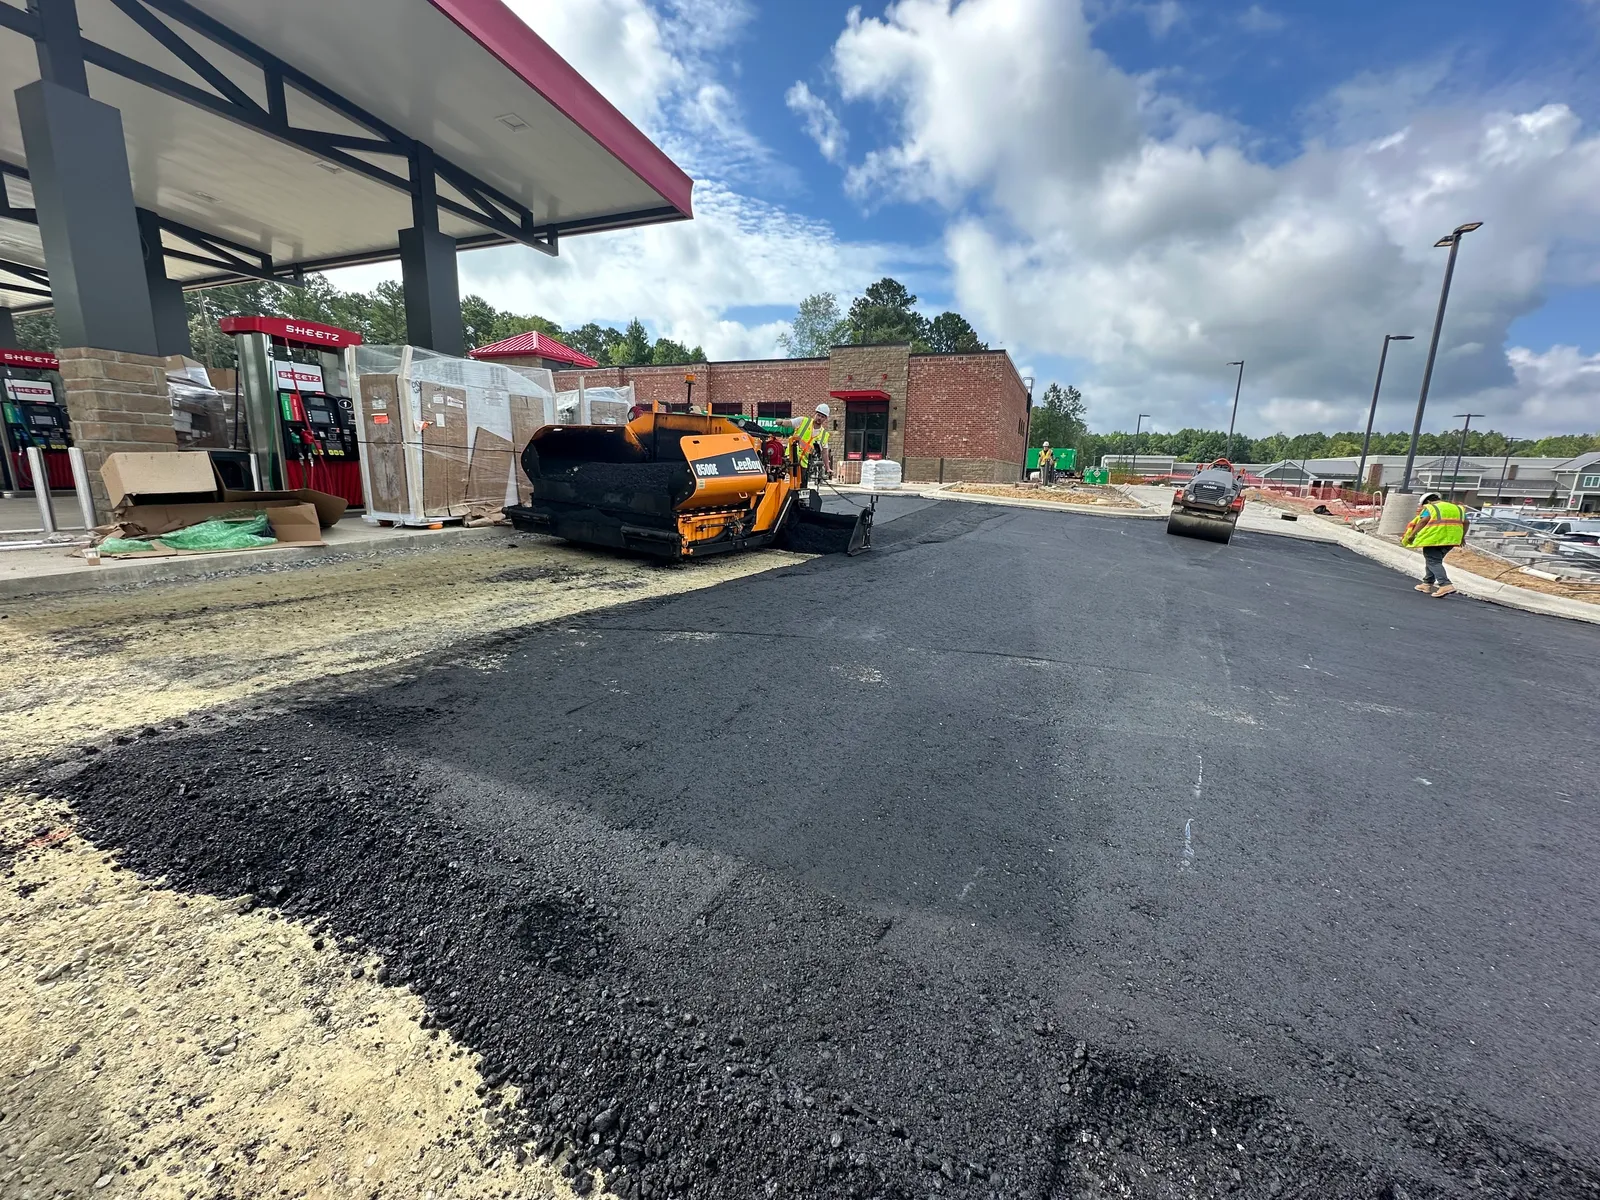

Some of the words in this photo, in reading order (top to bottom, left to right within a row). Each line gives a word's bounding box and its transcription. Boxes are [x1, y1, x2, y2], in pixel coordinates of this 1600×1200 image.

[286, 324, 340, 341] SHEETZ
[4, 353, 59, 365] SHEETZ
[695, 463, 719, 476] 8500E
[731, 457, 763, 474] LeeBoy
